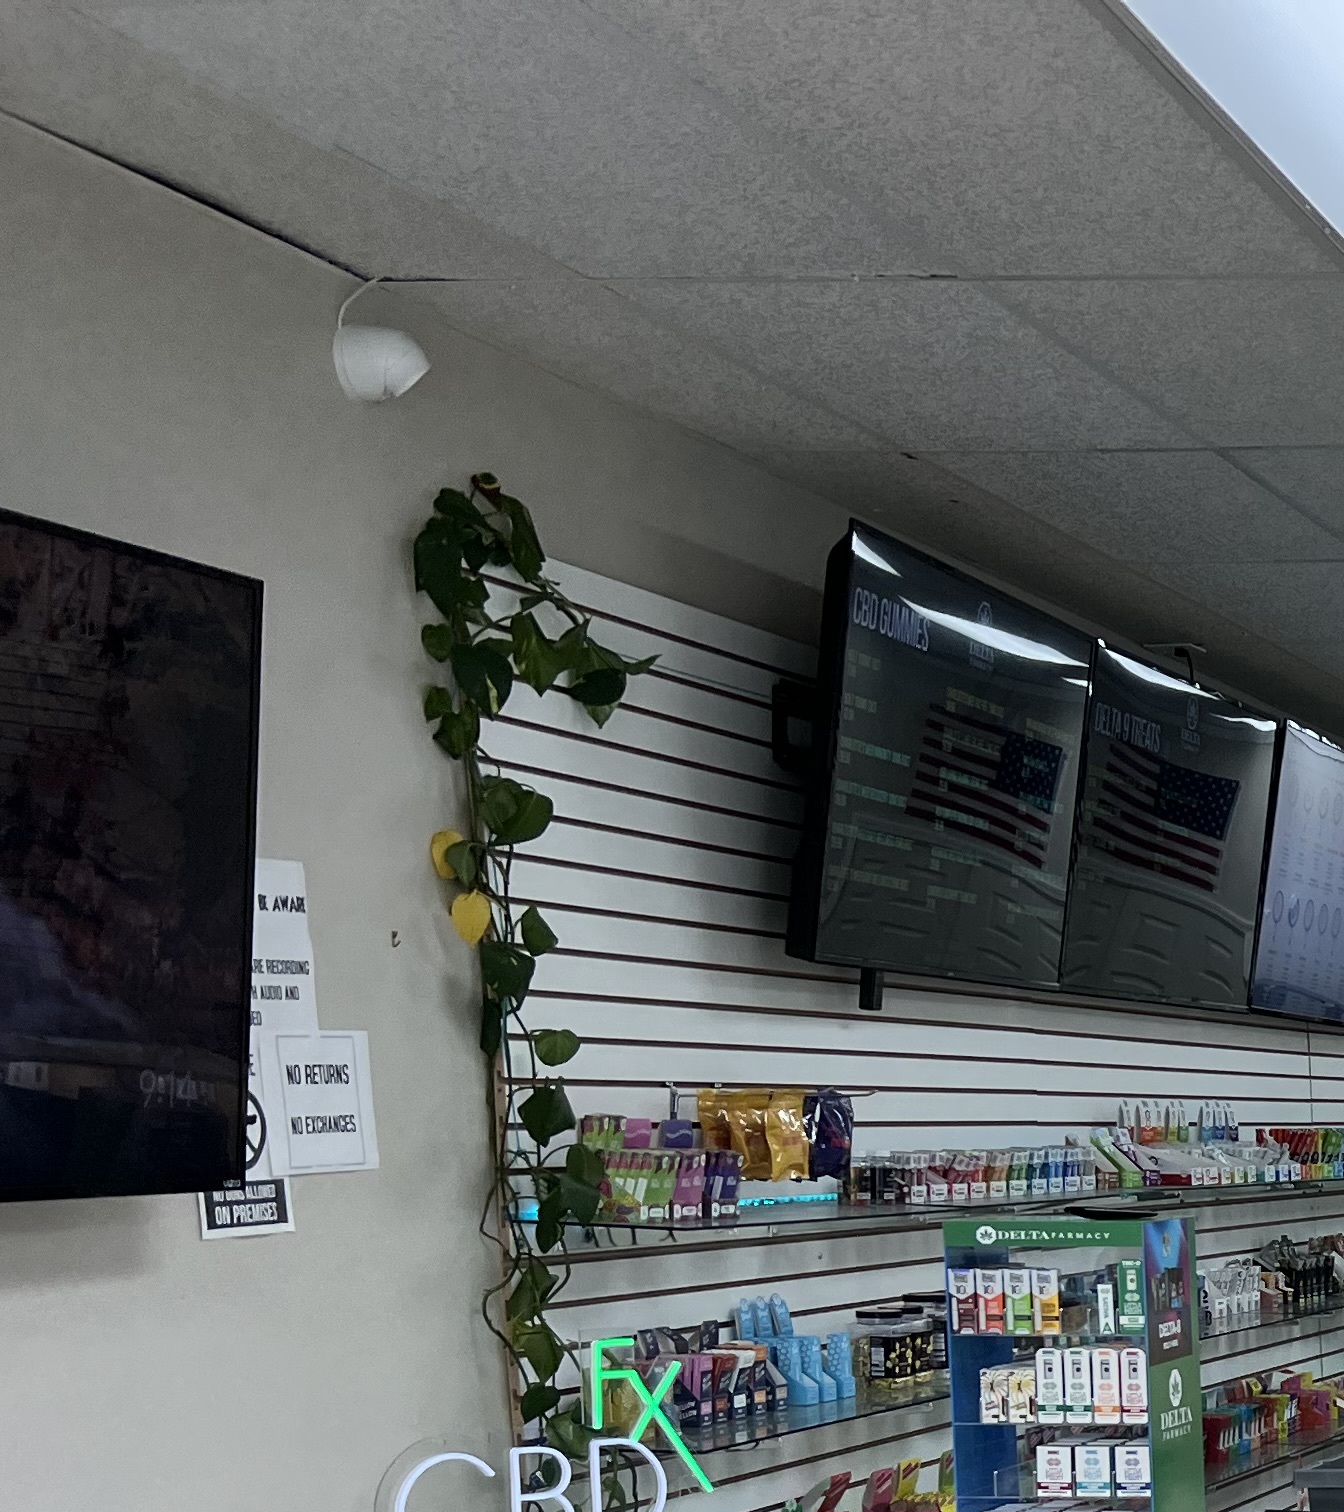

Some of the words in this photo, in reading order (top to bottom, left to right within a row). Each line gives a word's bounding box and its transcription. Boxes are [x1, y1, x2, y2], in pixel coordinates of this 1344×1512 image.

[852, 587, 879, 630] CBD
[879, 597, 931, 652] GUMMIES
[286, 1064, 300, 1085] NO
[304, 1064, 350, 1085] RETURNS
[290, 1117, 303, 1134] NO
[306, 1115, 357, 1134] EXCHANGES
[214, 1206, 231, 1225] ON
[233, 1202, 278, 1224] PREMISES
[997, 1230, 1050, 1240] DELTA
[1051, 1232, 1110, 1240] FARMACY
[1160, 1406, 1193, 1431] DELTA
[1161, 1424, 1192, 1442] FARMACY
